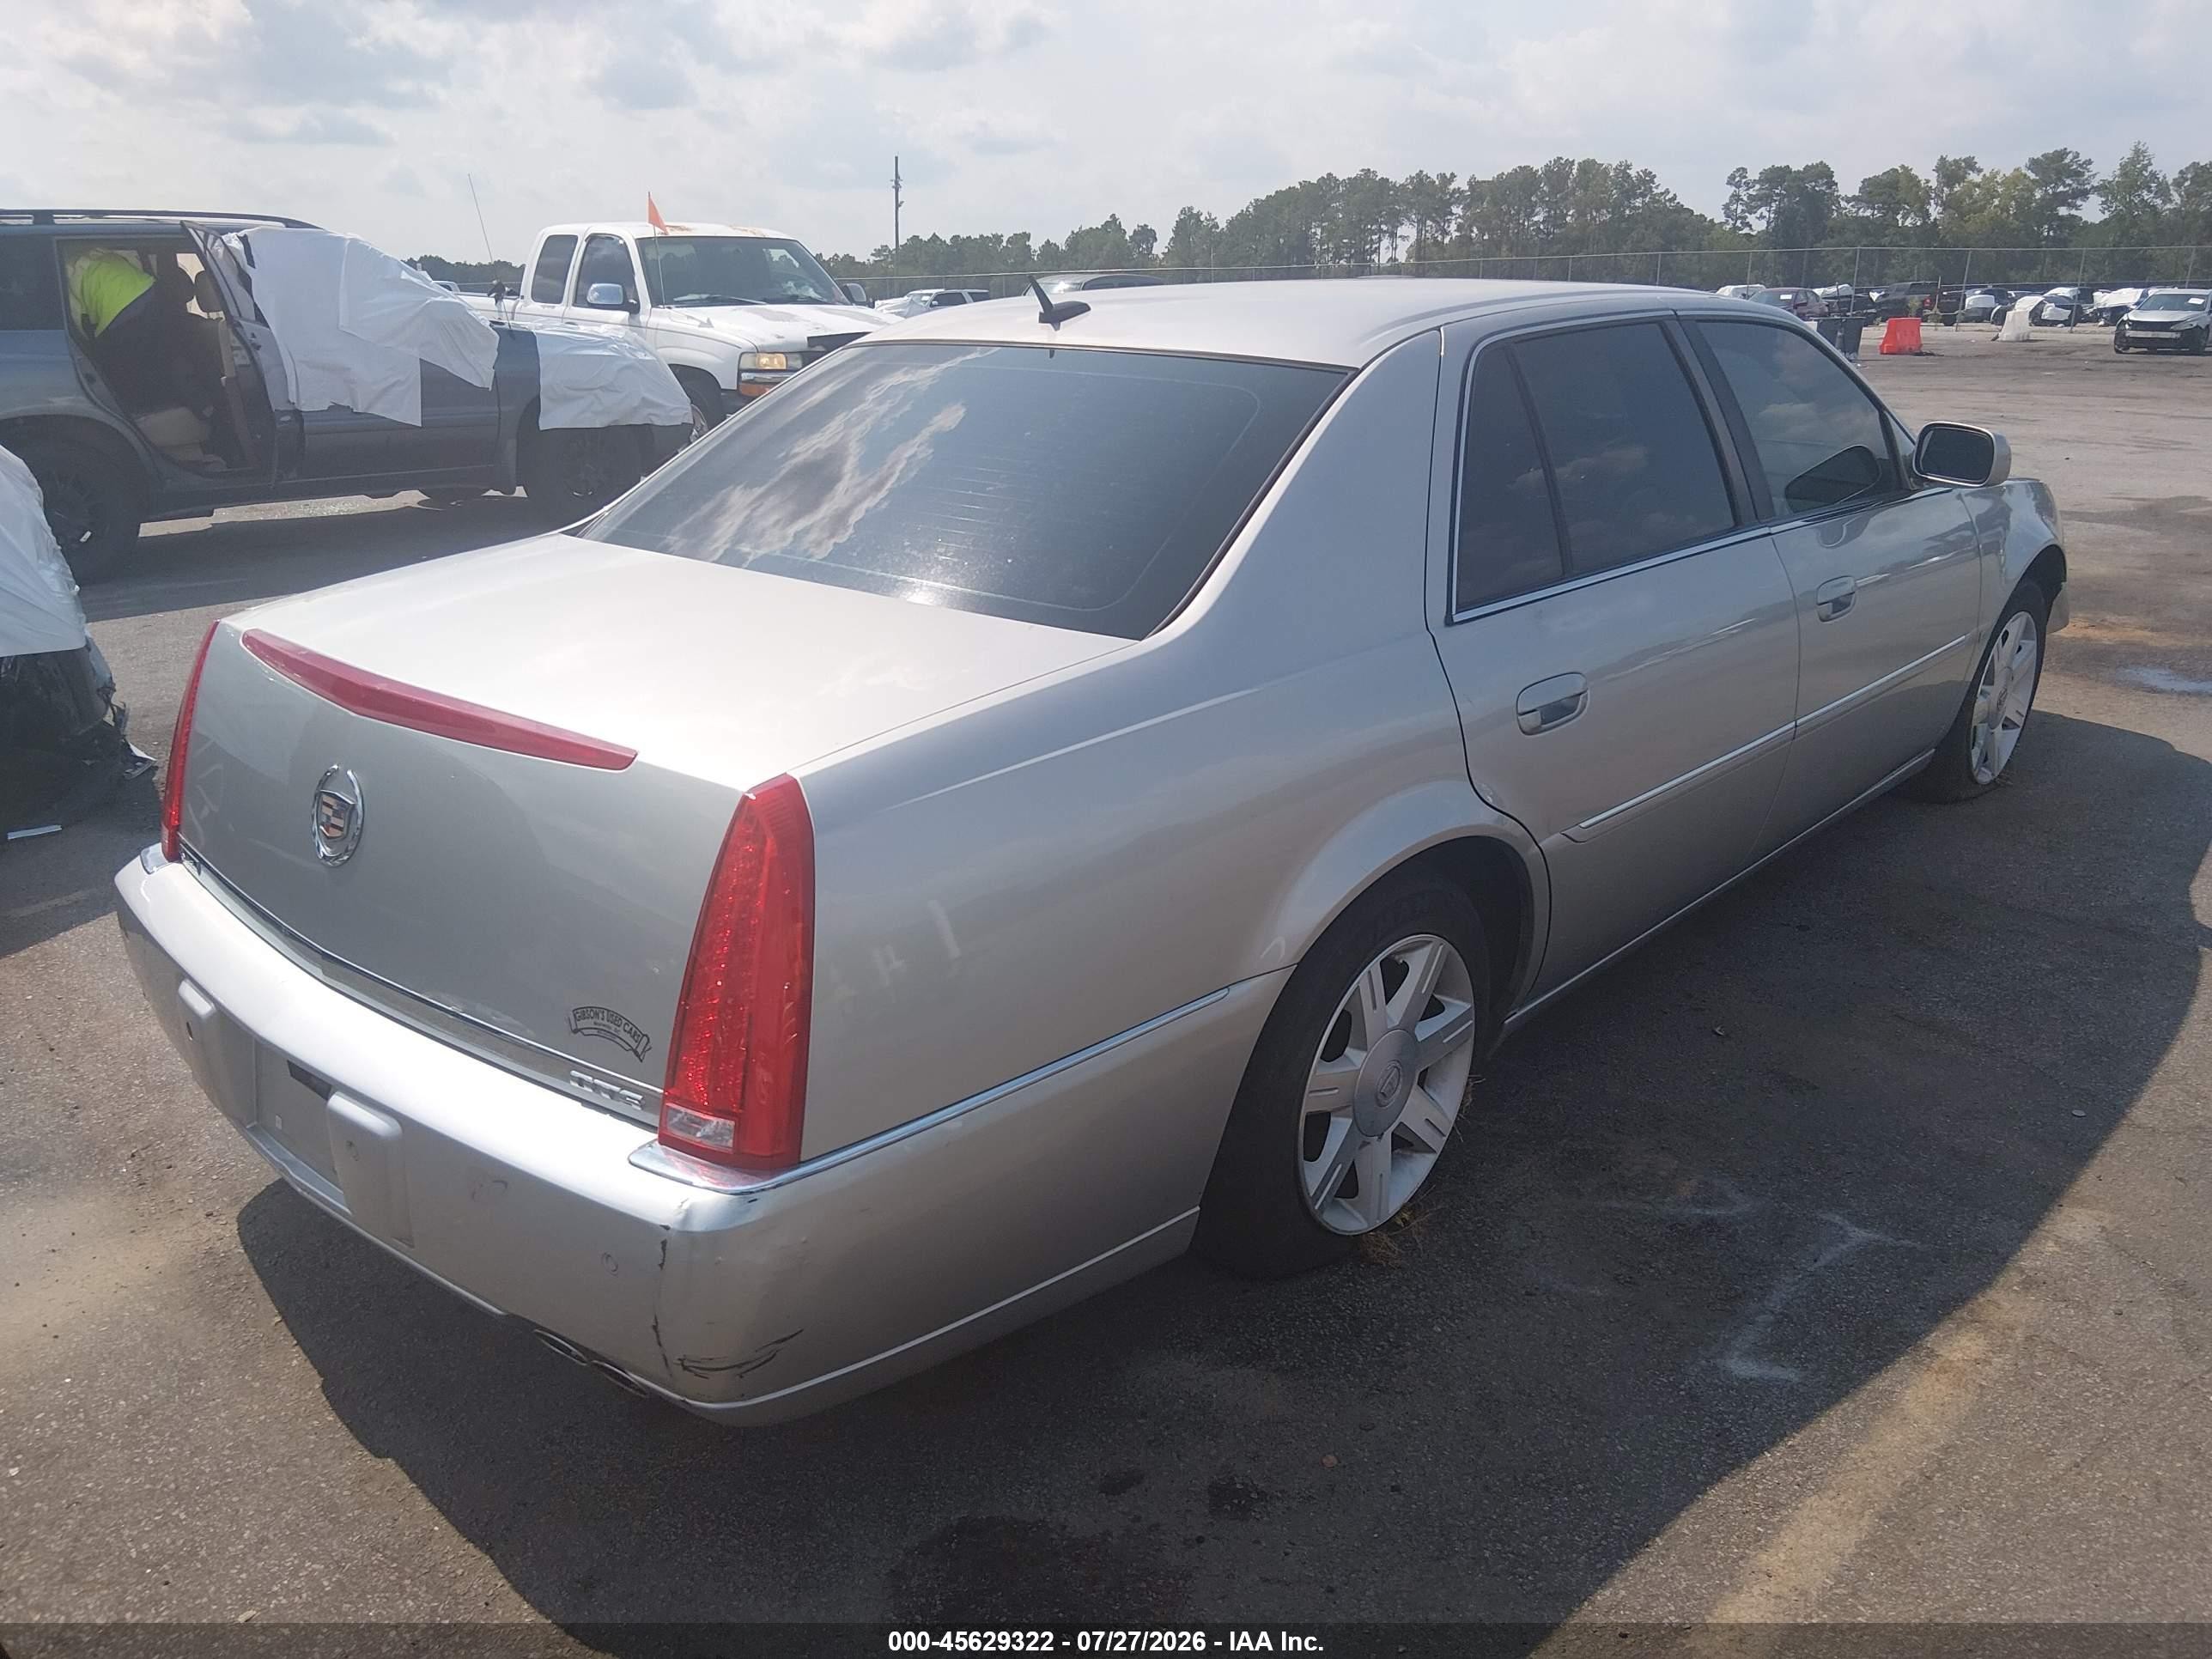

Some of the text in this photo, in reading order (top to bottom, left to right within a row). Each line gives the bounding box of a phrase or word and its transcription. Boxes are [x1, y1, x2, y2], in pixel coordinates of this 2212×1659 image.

[576, 1008, 605, 1022] GIBSON'S
[606, 1010, 623, 1028] USED
[623, 1022, 641, 1043] CARS
